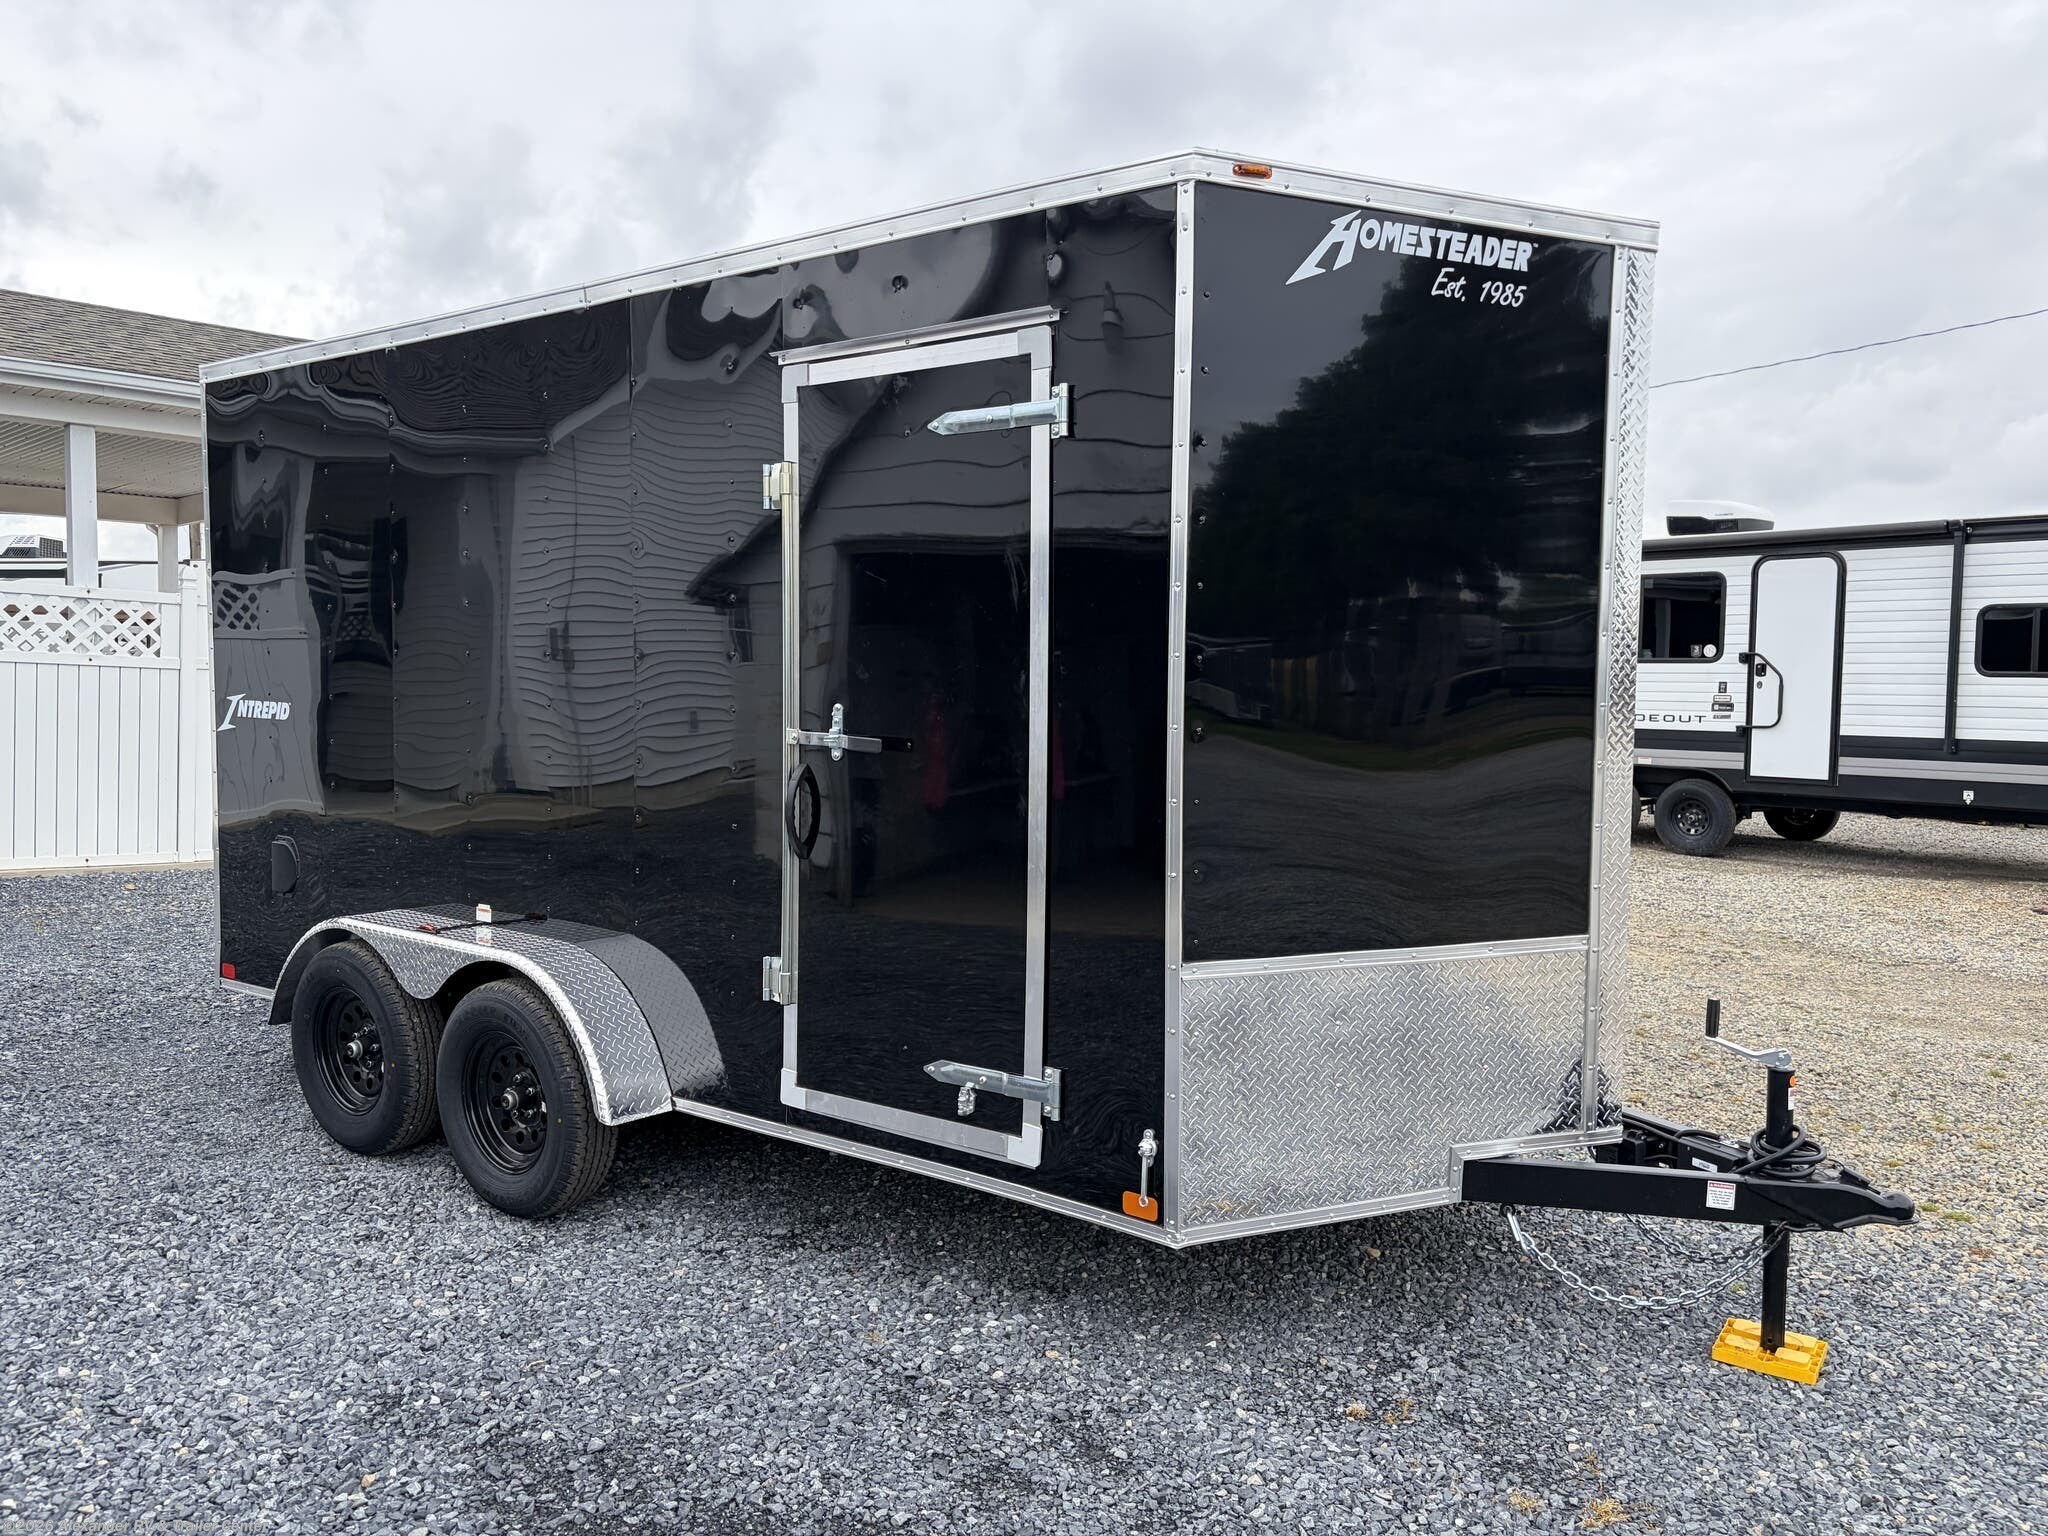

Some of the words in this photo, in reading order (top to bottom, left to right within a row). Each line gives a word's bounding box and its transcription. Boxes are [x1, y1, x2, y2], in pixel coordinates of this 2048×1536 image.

[1431, 267, 1467, 302] Est.
[1479, 281, 1528, 308] 1985
[216, 693, 291, 732] INTREPID
